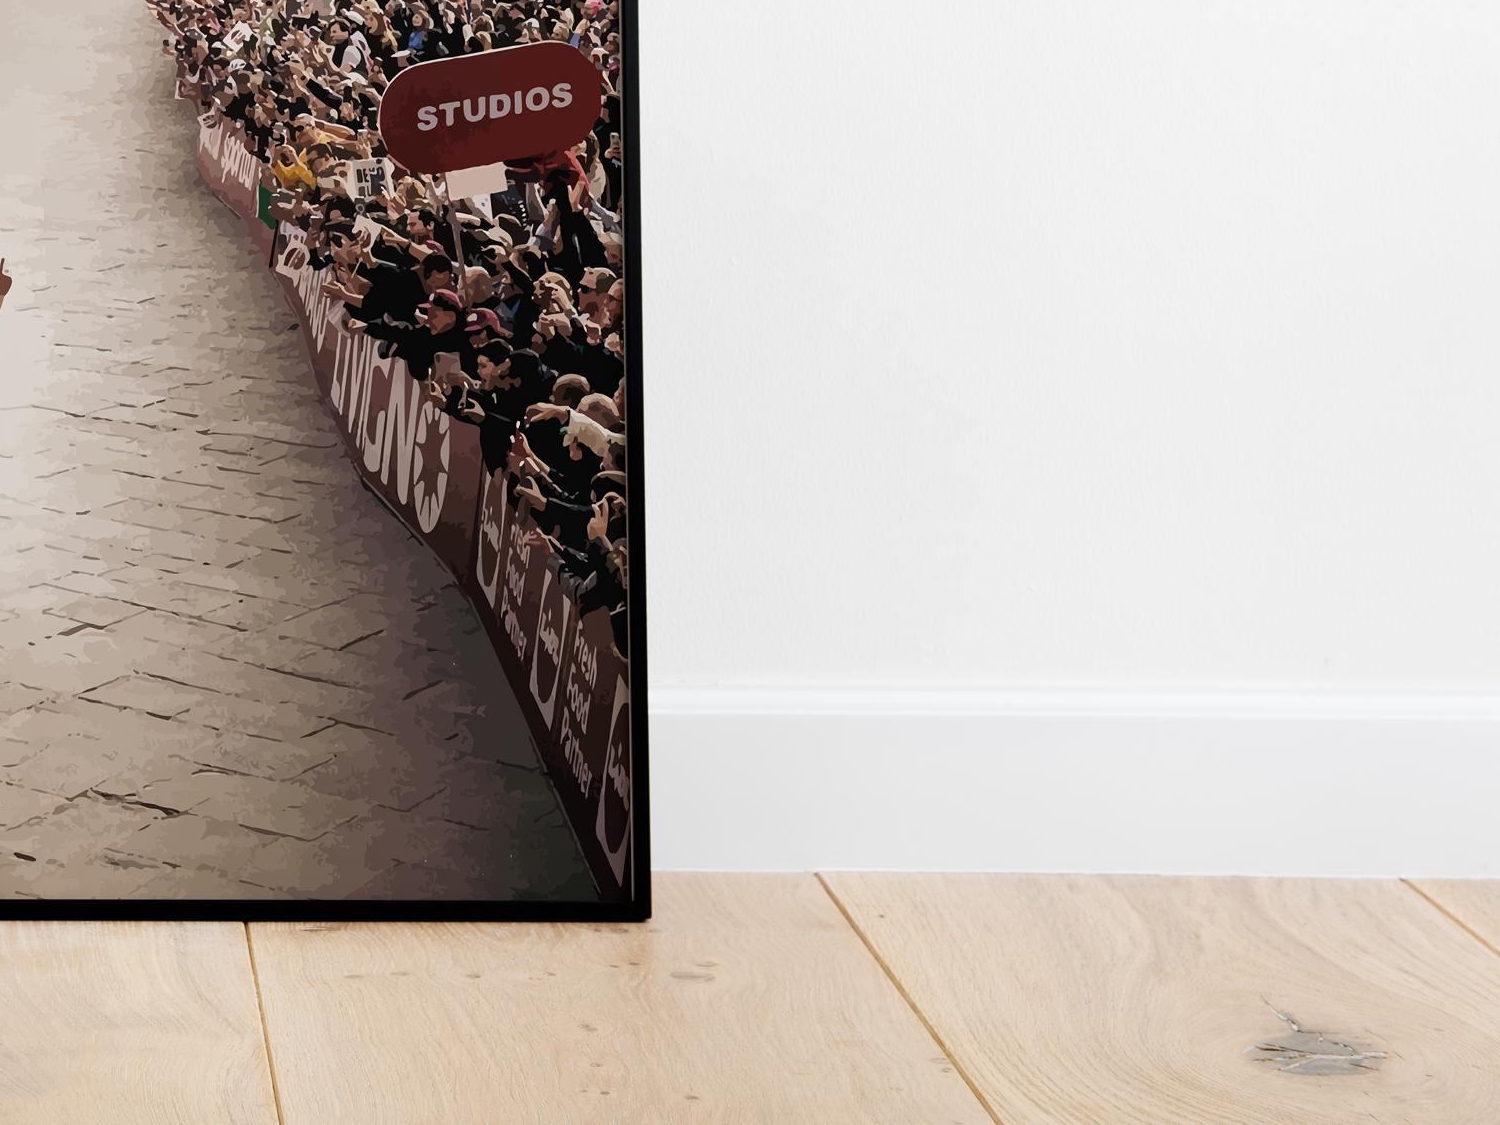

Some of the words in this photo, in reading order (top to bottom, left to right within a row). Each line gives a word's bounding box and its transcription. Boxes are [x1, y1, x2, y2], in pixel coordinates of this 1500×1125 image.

[417, 82, 573, 132] STUDIOS
[573, 618, 598, 690] Fresh
[566, 662, 591, 735] Food
